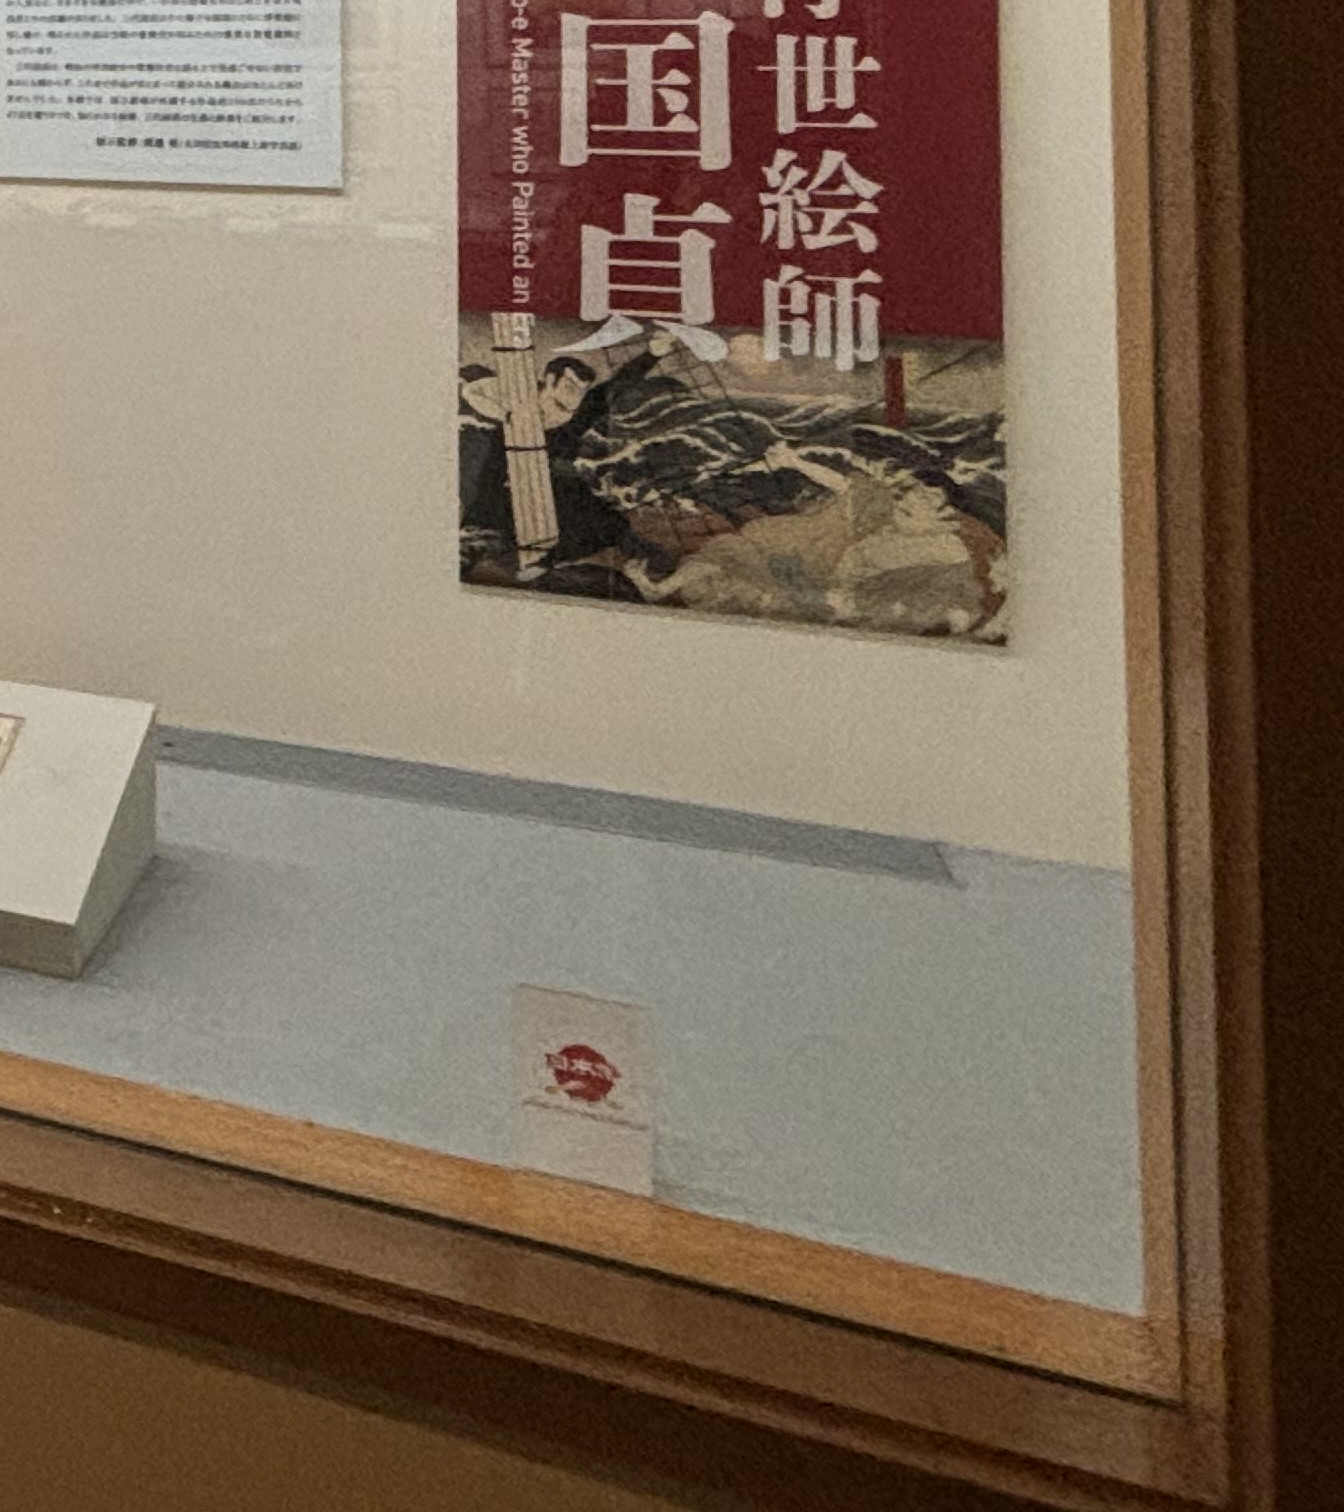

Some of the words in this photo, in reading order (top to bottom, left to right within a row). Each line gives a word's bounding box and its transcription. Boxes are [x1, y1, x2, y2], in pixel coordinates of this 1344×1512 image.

[511, 37, 535, 120] Master
[511, 126, 534, 174] who
[512, 182, 535, 269] Painted
[512, 274, 530, 304] an
